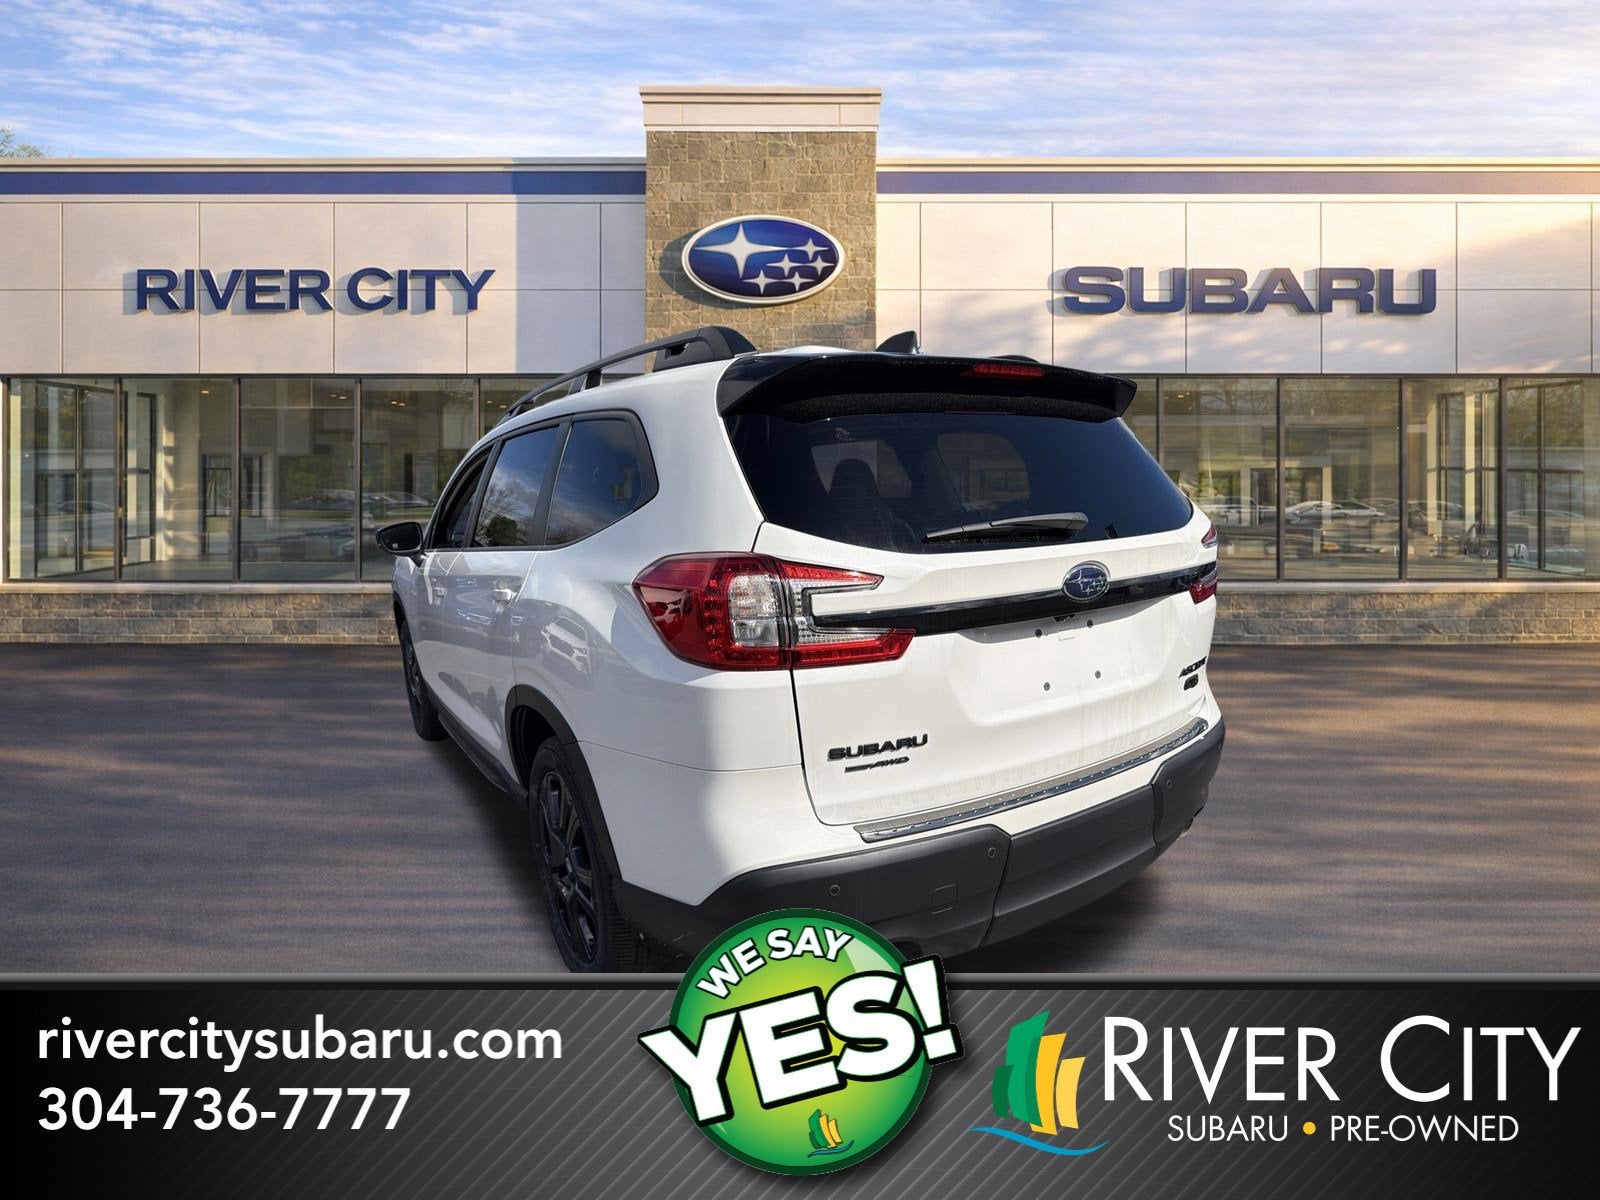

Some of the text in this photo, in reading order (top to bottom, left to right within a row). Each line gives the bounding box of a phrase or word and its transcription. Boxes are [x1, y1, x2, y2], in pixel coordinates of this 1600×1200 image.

[136, 267, 496, 312] RIVER CITY
[1063, 266, 1437, 315] SUBARU
[827, 733, 928, 761] SUBARU
